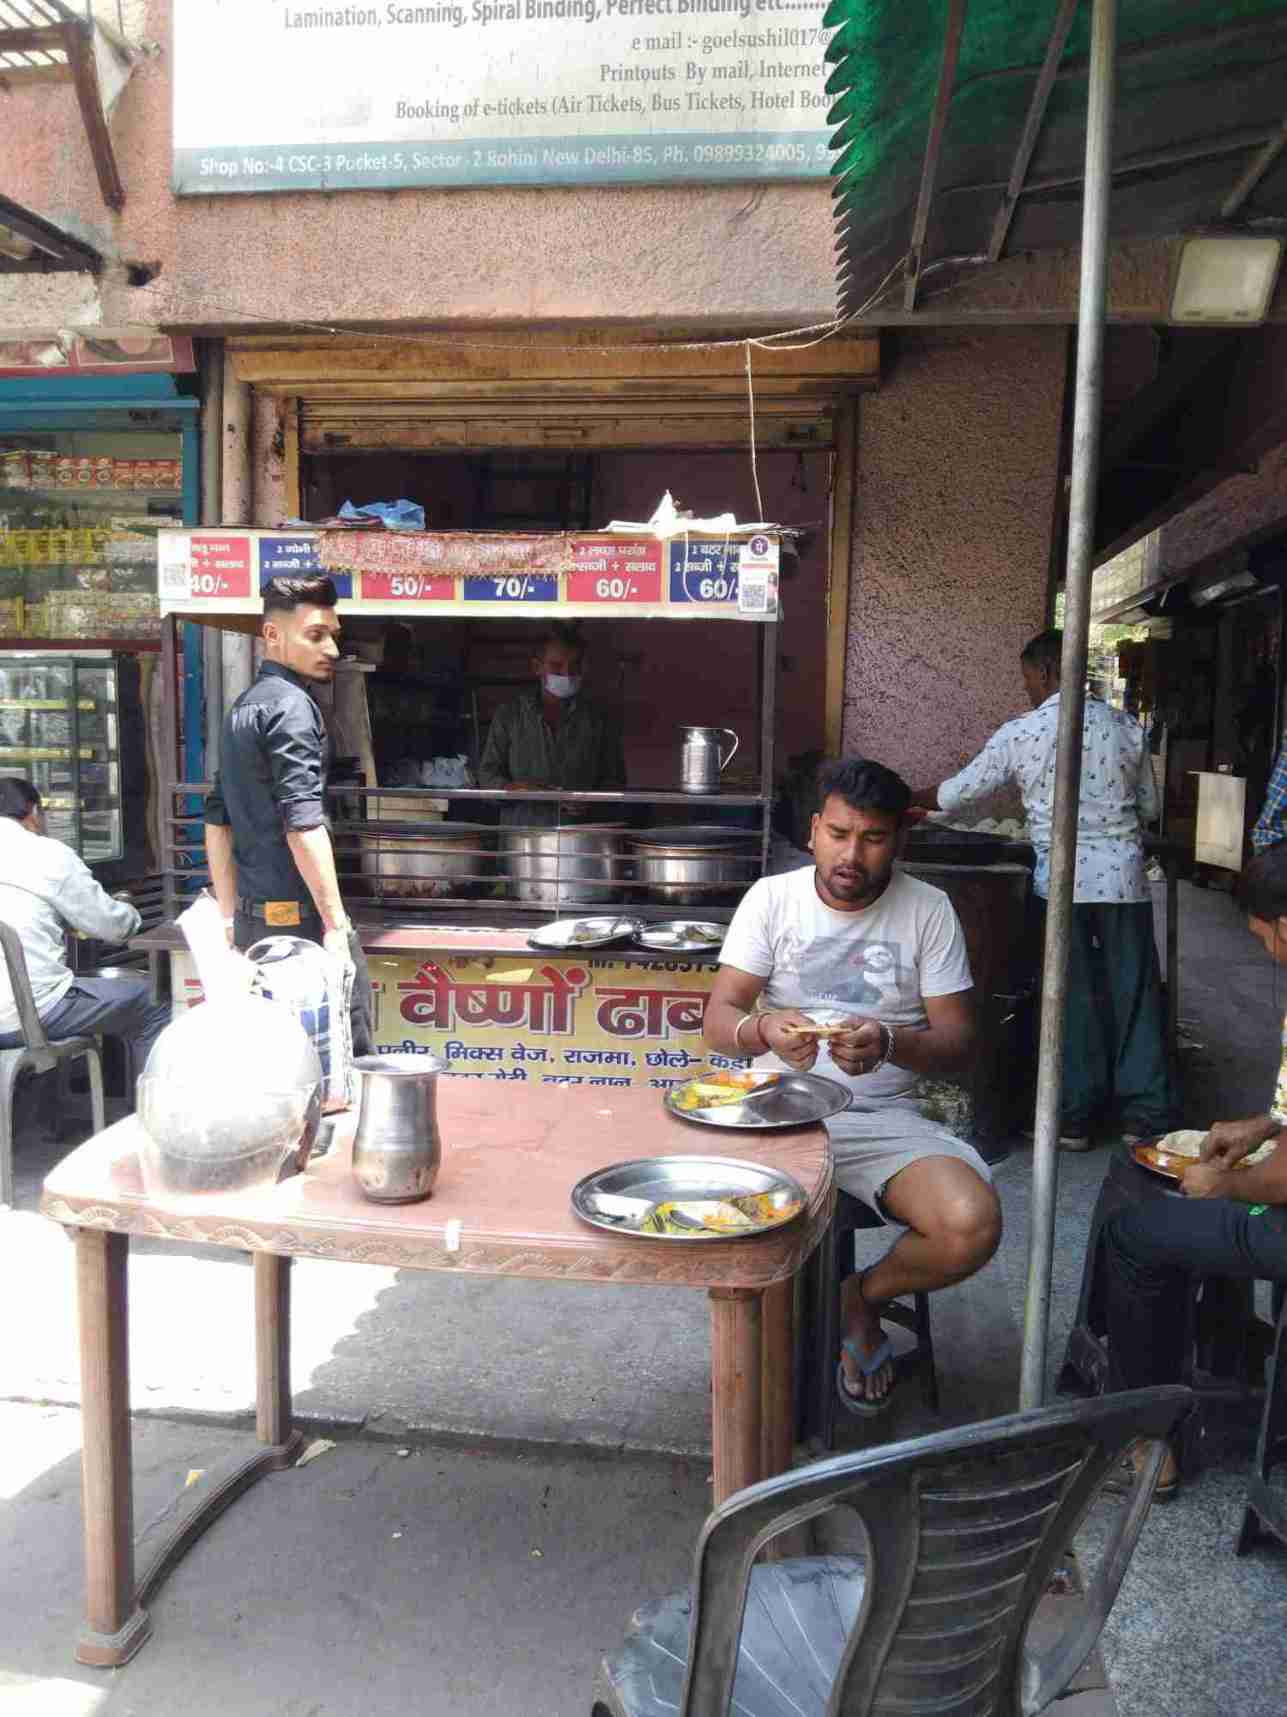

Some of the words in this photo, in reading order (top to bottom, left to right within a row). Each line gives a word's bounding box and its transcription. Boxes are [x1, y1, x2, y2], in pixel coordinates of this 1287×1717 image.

[284, 6, 383, 29] Lamination,
[387, 2, 469, 29] Scanning,
[472, 0, 521, 26] Spiral
[525, 0, 602, 23] Binding,
[606, 0, 673, 16] Perfect
[600, 63, 676, 83] Printouts
[686, 62, 707, 85] By
[712, 60, 753, 81] mail,
[759, 59, 827, 79] Internet
[396, 99, 460, 123] Booking
[463, 98, 480, 117] of
[483, 96, 547, 117] e-tickets
[552, 95, 584, 115] (Air
[588, 93, 647, 115] Tickets,
[652, 93, 680, 112] Bus
[685, 91, 745, 112] Tickets,
[750, 90, 795, 110] Hotel
[200, 157, 239, 177] Shop
[543, 149, 578, 167] New
[189, 573, 229, 594] 40/-
[390, 576, 432, 598] 50/-
[493, 576, 535, 599] 70/-
[596, 577, 638, 600] 60/-
[594, 986, 711, 1039] ढाब
[444, 1041, 503, 1062] मिक्स
